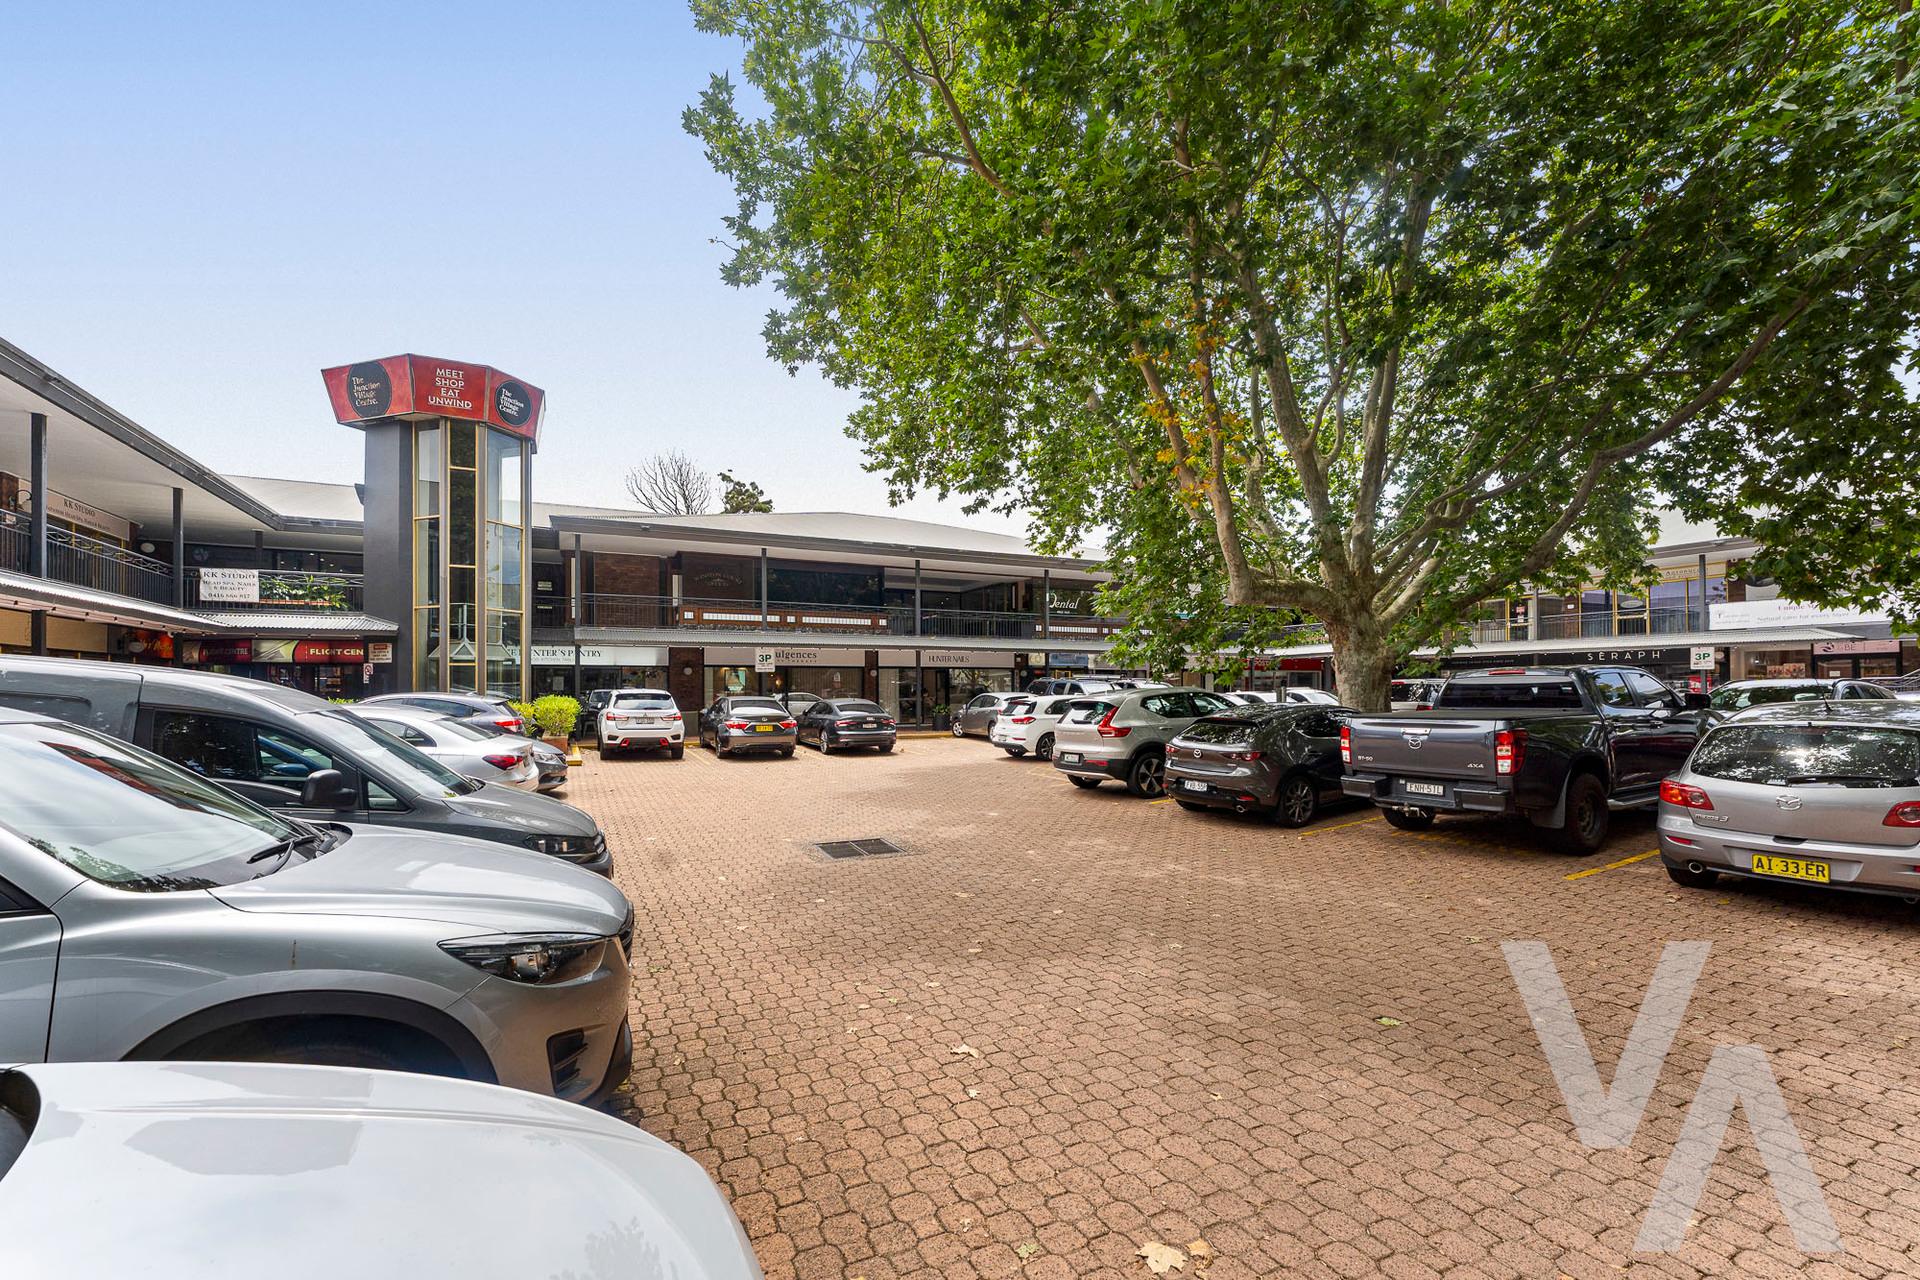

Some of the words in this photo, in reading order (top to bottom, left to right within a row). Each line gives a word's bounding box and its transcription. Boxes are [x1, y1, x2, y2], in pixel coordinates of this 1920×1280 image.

[436, 368, 464, 378] MEET
[352, 376, 364, 385] The
[435, 377, 465, 388] SHOP
[441, 388, 460, 398] EAT
[502, 388, 512, 397] The
[428, 396, 472, 408] UNWIND
[63, 498, 73, 509] KK
[1049, 592, 1080, 609] Dental
[568, 649, 602, 658] PNTRY
[758, 654, 771, 662] 3P
[775, 650, 817, 659] ulgences
[1587, 650, 1660, 661] SERAPH
[1695, 652, 1710, 660] 3P
